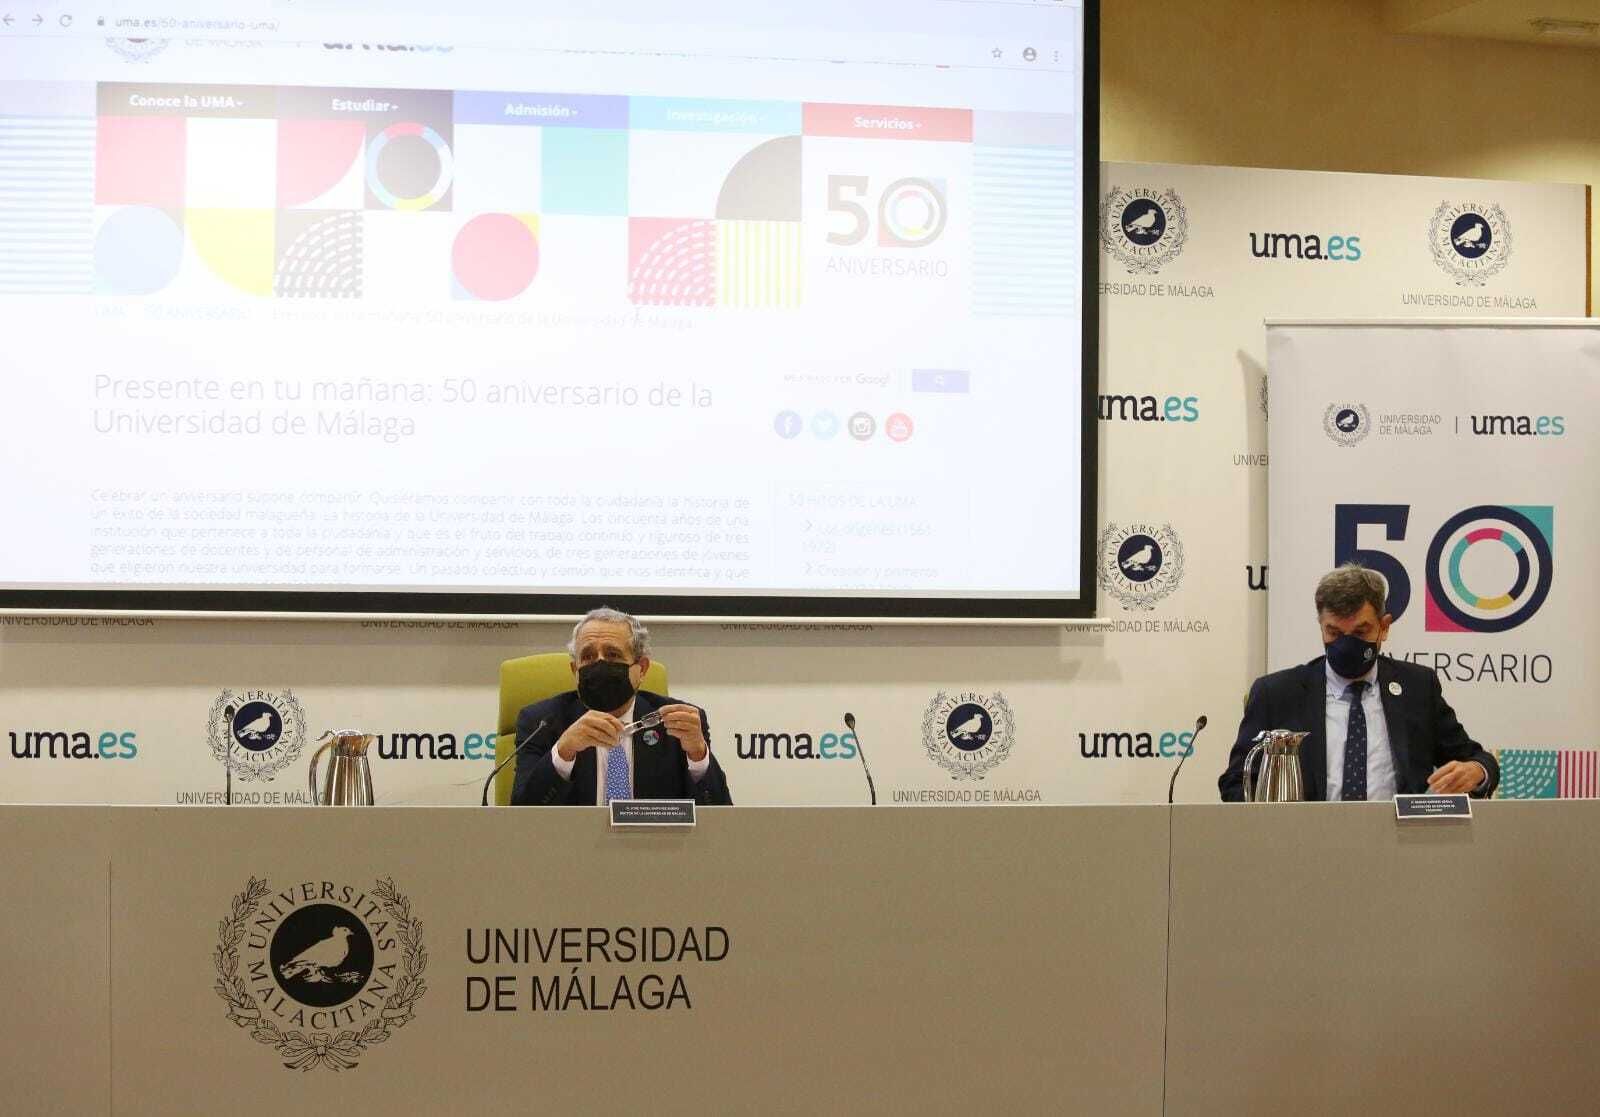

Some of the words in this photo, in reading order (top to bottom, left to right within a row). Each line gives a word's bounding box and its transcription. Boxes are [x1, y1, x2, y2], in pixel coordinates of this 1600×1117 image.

[129, 94, 180, 107] Conoce
[184, 95, 197, 107] la
[201, 95, 235, 108] UMA
[332, 99, 389, 112] Estudiar
[505, 103, 570, 118] Admisión
[854, 116, 914, 131] Servicios
[825, 173, 948, 249] 50
[1250, 231, 1362, 261] uma.es
[825, 256, 949, 278] ANIVERSARIO
[1099, 283, 1146, 296] ERSIDAD
[1149, 285, 1165, 296] DE
[1402, 293, 1475, 307] UNIVERSIDAD
[1477, 296, 1492, 308] DE
[94, 374, 219, 400] Presente
[229, 381, 264, 400] en
[273, 379, 301, 400] tu
[312, 377, 432, 402] mañana:
[443, 378, 477, 404] 50
[486, 379, 640, 407] aniversario
[648, 382, 681, 407] de
[690, 383, 713, 408] la
[93, 410, 262, 435] Universidad
[271, 411, 306, 436] de
[316, 409, 416, 443] Málaga
[1379, 414, 1441, 425] UNIVERSIDAD
[1471, 415, 1565, 436] uma.es
[1379, 425, 1392, 435] DE
[1145, 621, 1160, 632] DE
[9, 731, 138, 760] uma.es
[735, 729, 858, 760] uma.es
[1079, 730, 1196, 760] uma.es
[264, 792, 280, 804] DE
[893, 790, 972, 802] UNIVERSIDAD
[975, 790, 990, 801] DE
[247, 880, 397, 951] UNIVERSITAS
[465, 926, 730, 964] UNIVERSIDAD
[246, 961, 397, 1030] MALACITANA
[465, 976, 517, 1012] DE
[530, 966, 692, 1011] MÁLAGA
